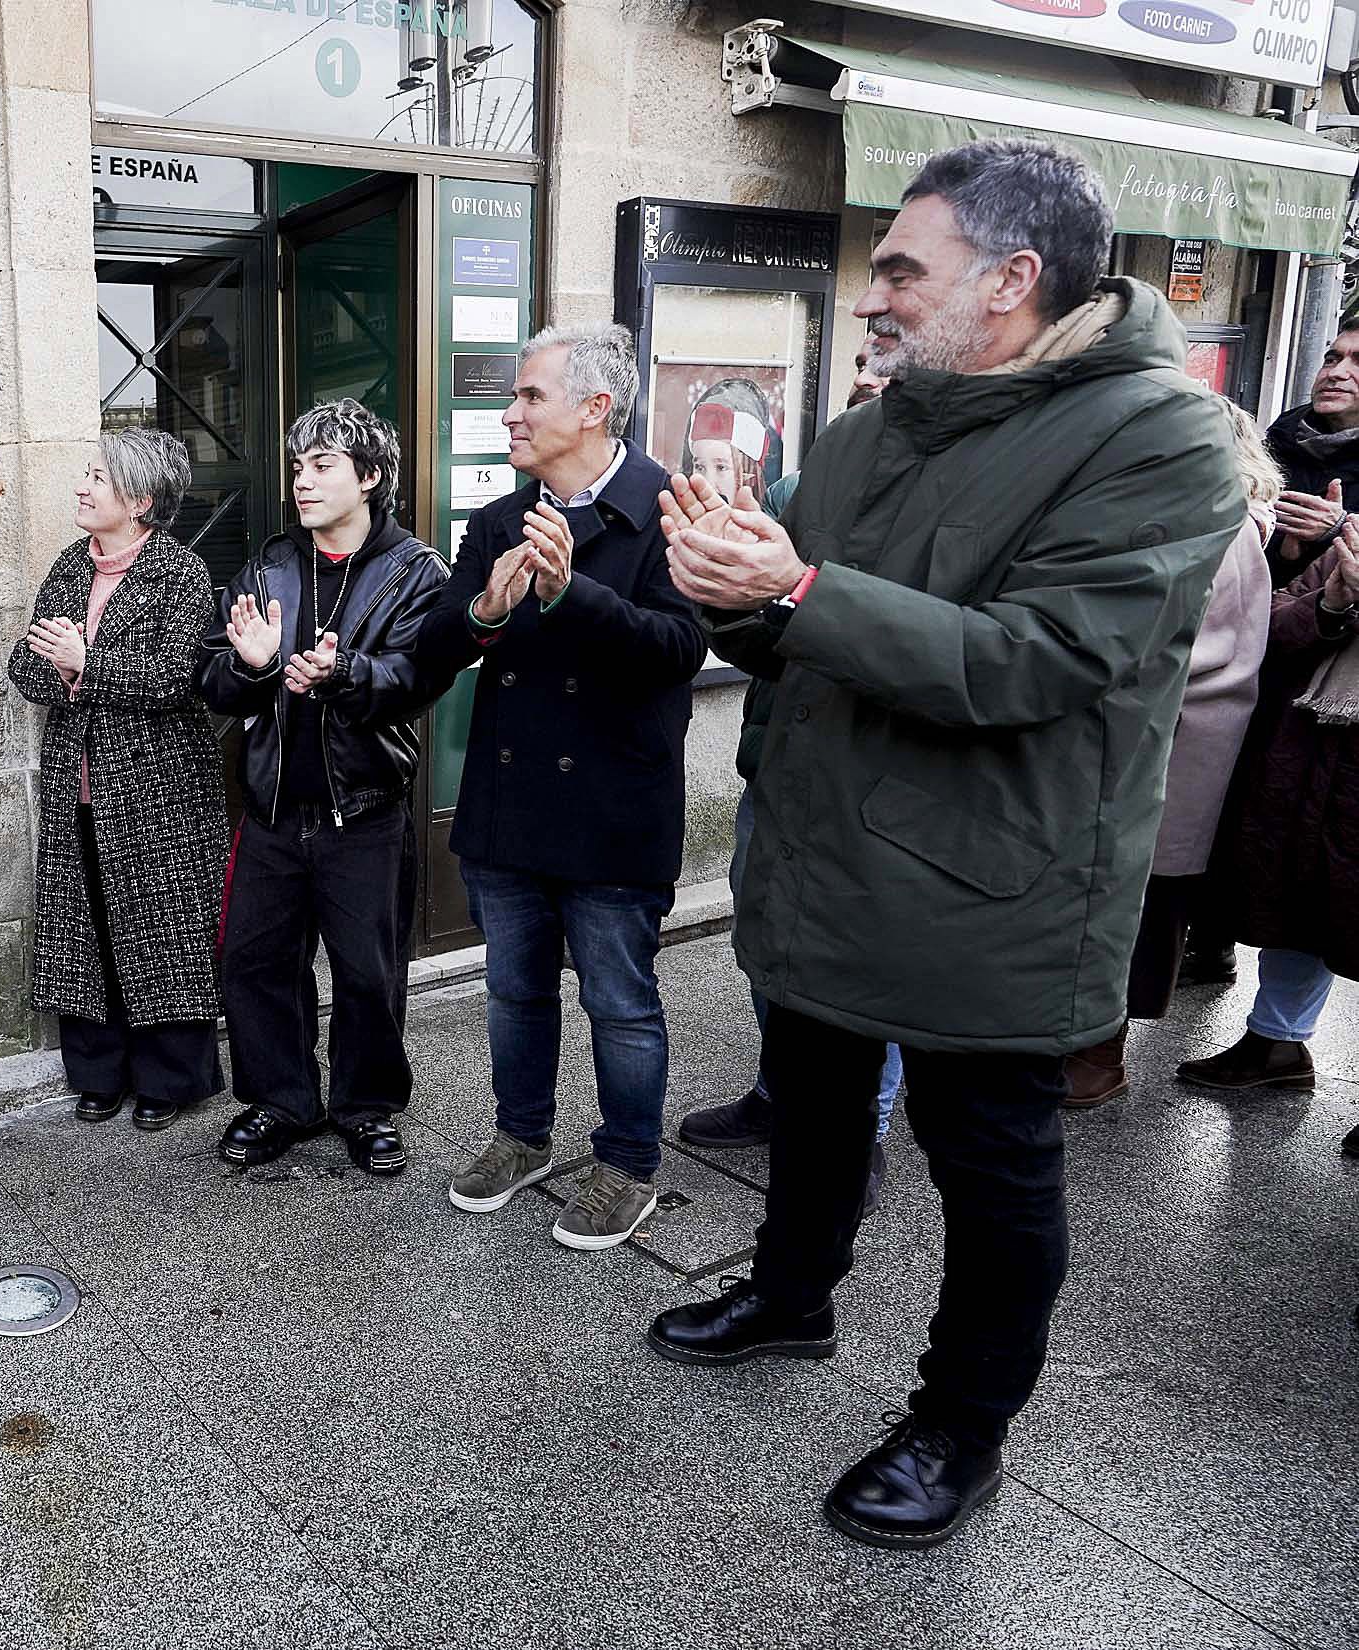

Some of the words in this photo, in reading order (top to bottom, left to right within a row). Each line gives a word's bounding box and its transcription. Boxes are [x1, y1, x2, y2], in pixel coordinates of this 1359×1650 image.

[355, 0, 467, 39] ESPAÑA
[1143, 8, 1172, 29] FOTO
[1173, 15, 1213, 38] CARNET
[1253, 27, 1318, 65] OLIMPIO
[326, 47, 343, 85] 1
[110, 156, 198, 183] ESPAÑA
[1115, 164, 1240, 217] fotografía
[451, 196, 522, 218] OFICINAS
[1275, 198, 1296, 217] foto
[1298, 202, 1336, 221] carnet
[660, 230, 726, 265] Olimpio
[1174, 252, 1201, 264] ALARMA
